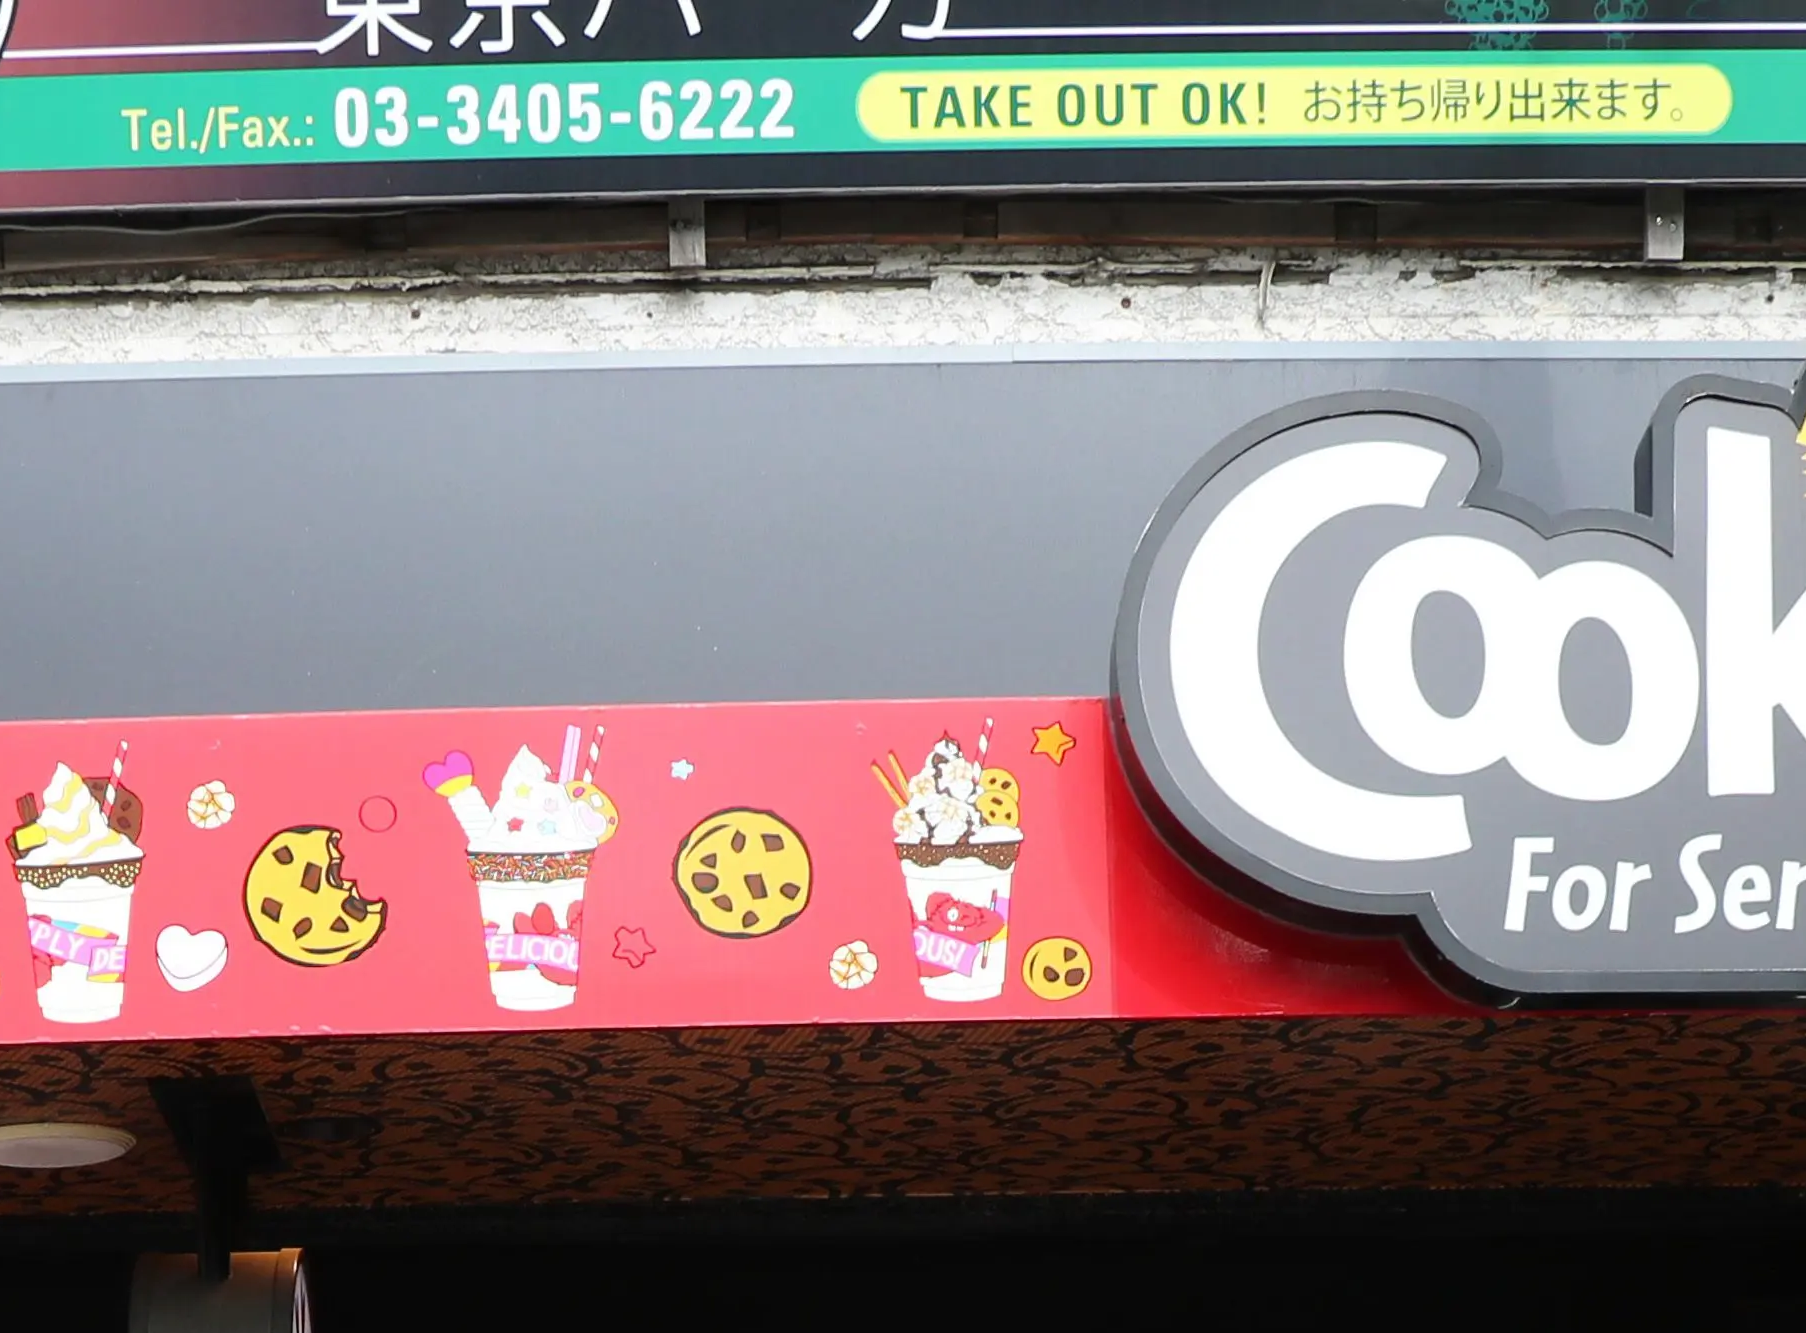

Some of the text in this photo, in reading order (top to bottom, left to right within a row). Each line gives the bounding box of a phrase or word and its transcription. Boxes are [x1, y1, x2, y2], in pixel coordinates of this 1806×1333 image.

[333, 78, 795, 148] 03-3405-6222
[900, 79, 1268, 130] TAKE OUT OK!
[1302, 76, 1685, 126] お持ち帰り出来ます。
[1502, 832, 1654, 935] For
